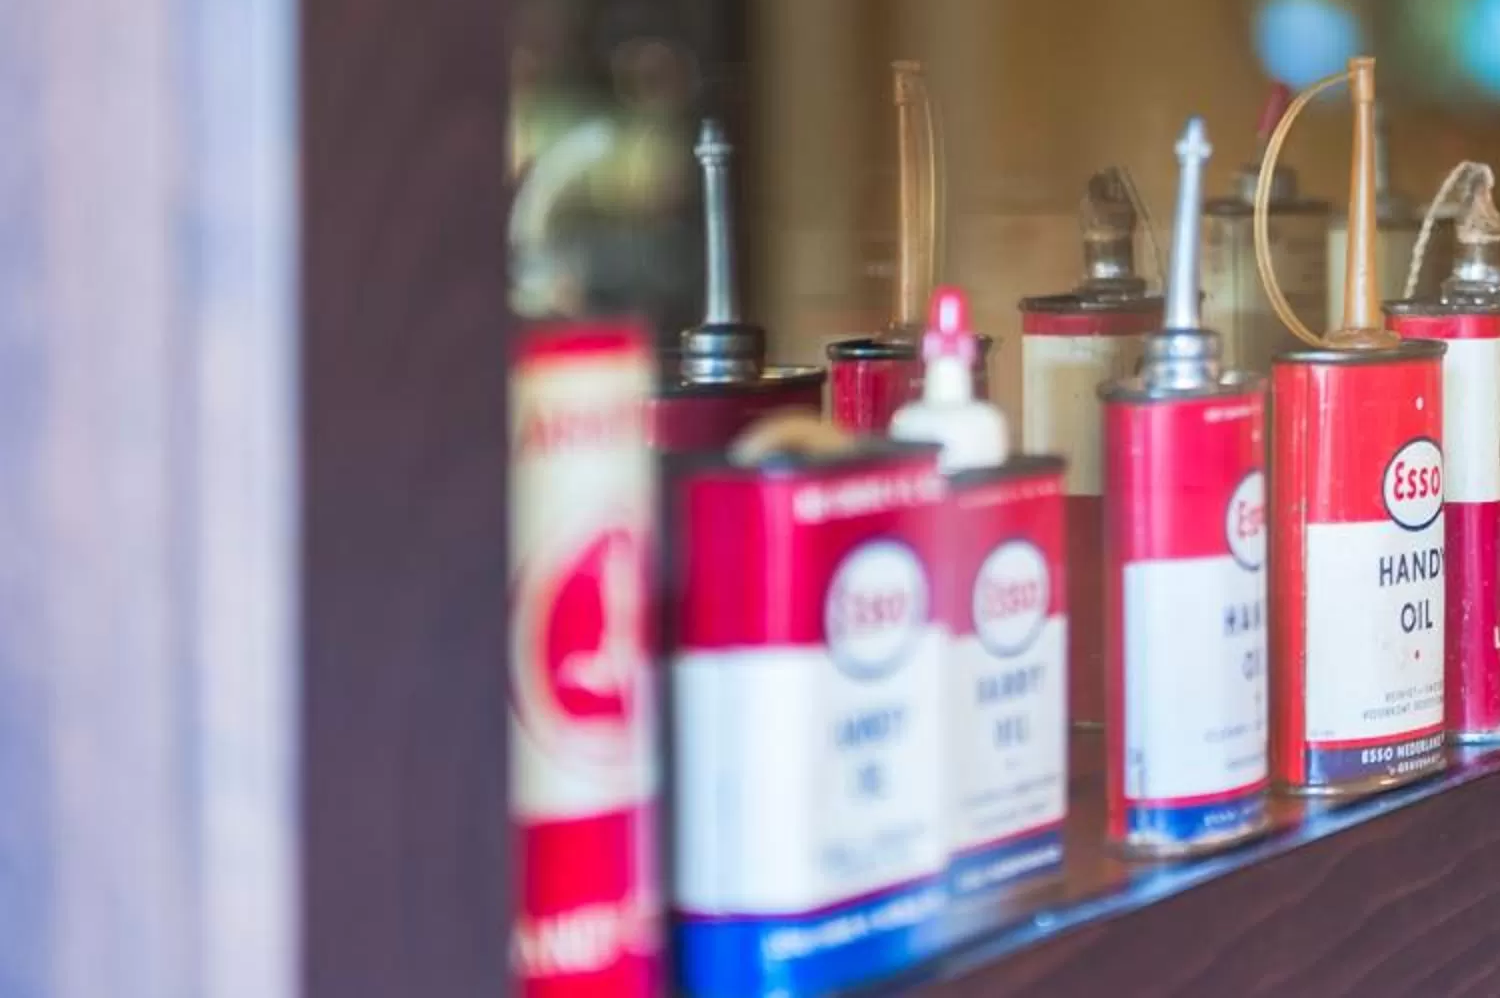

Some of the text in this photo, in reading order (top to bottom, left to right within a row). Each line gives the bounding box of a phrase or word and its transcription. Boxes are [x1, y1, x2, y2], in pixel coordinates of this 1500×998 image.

[1393, 460, 1441, 502] Esso
[1379, 548, 1444, 587] HAND
[1400, 599, 1434, 633] OIL
[1361, 746, 1394, 765] ESSO
